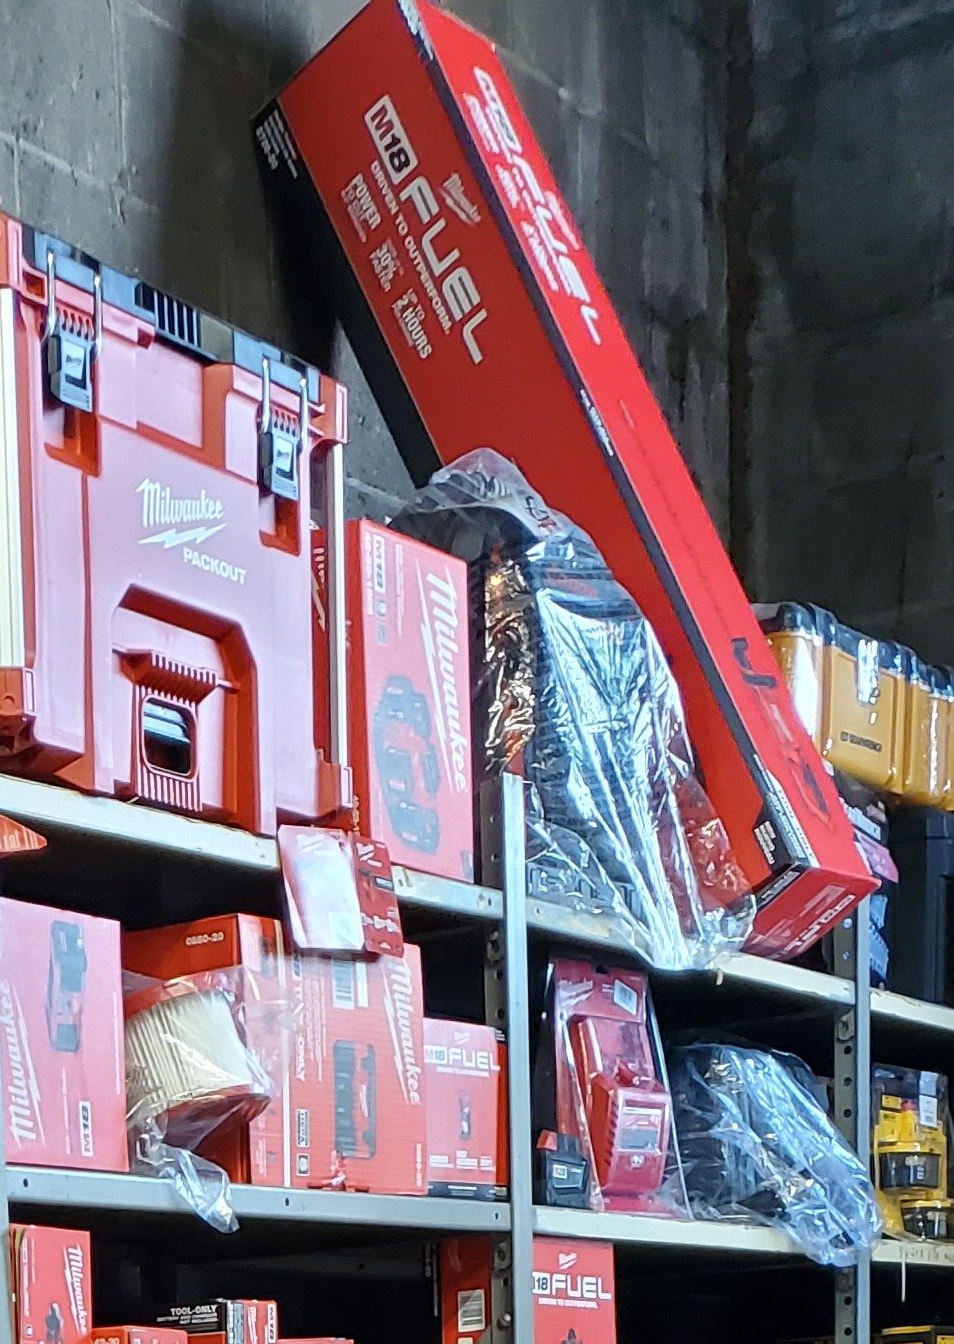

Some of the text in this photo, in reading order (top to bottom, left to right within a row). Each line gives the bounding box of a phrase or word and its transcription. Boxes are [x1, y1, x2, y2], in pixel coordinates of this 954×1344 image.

[349, 173, 382, 231] POWER
[371, 160, 409, 237] DRIVEN TO
[371, 103, 487, 364] M18 FUEL
[402, 306, 433, 360] HOURS
[135, 478, 226, 529] Milwaukee
[182, 547, 247, 585] PACKOUT
[425, 560, 467, 793] Milwaukee
[389, 957, 423, 1107] Milwaukee
[449, 1047, 501, 1072] FUEL
[0, 979, 37, 1150] Milwaukee
[80, 1106, 93, 1153] M18
[66, 1243, 89, 1336] Milwaukee
[170, 1304, 218, 1316] TOOL-ONLY
[552, 1272, 613, 1300] FUEL
